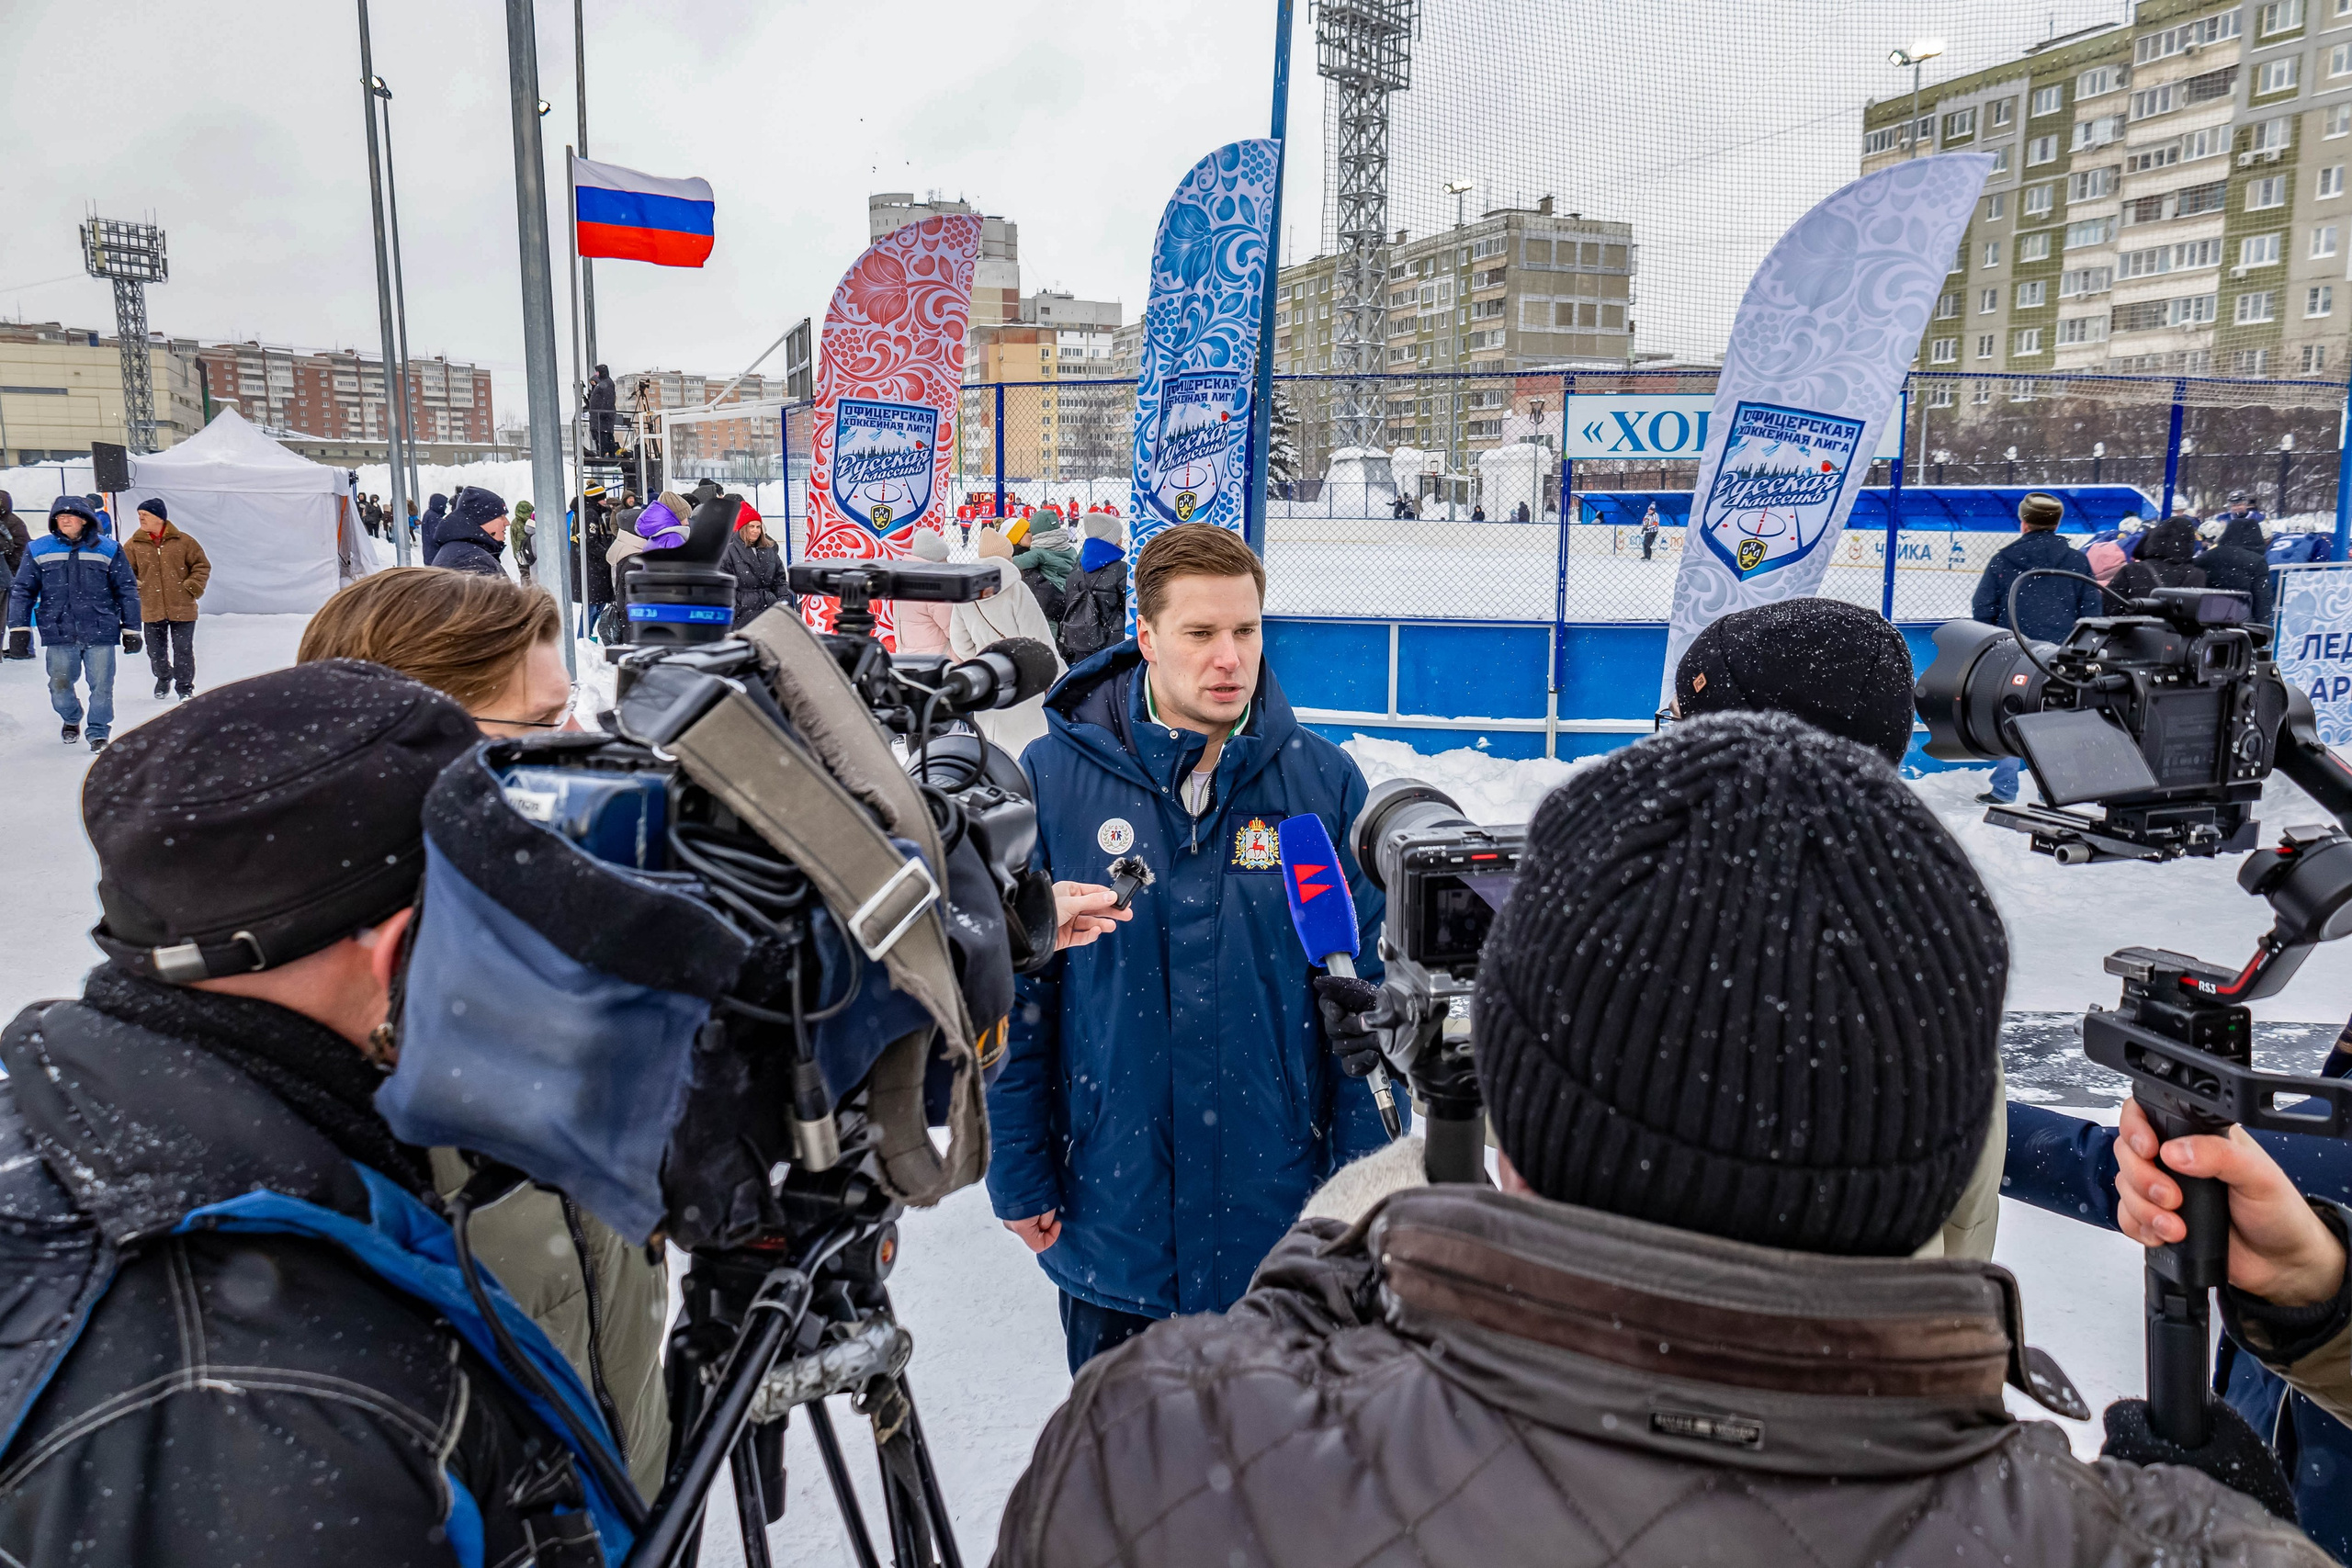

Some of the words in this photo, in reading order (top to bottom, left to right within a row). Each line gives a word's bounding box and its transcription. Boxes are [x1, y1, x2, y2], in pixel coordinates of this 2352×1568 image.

[844, 405, 933, 424] ОФИЦЕРСКАЯ
[906, 423, 932, 434] ЛИГА
[1742, 410, 1857, 440] ОФИЦЕРСКАЯ
[1813, 437, 1850, 453] ЛИГА
[837, 448, 932, 482] Русская
[862, 462, 925, 482] классика
[1714, 469, 1841, 507] Русская
[1737, 487, 1825, 508] классика
[874, 507, 888, 519] ОХЛ
[1742, 542, 1761, 557] ОХЛ
[1875, 535, 1932, 560] ЧЙКА
[2014, 674, 2026, 685] G
[2198, 980, 2217, 994] RS3
